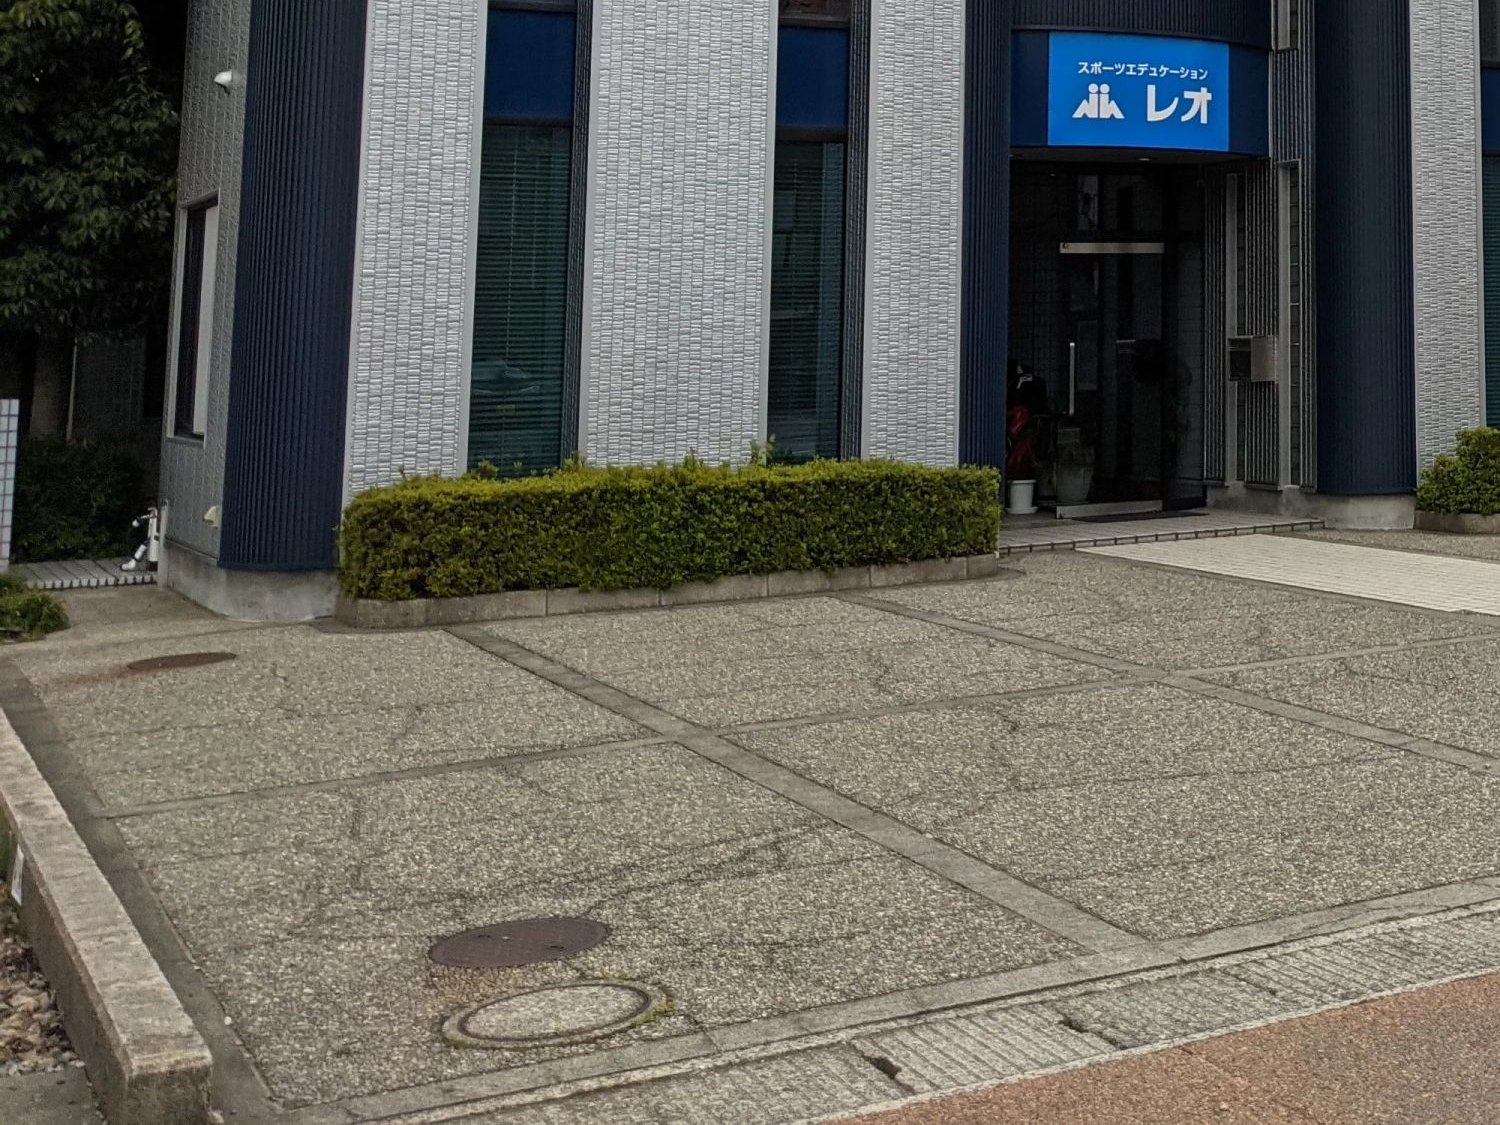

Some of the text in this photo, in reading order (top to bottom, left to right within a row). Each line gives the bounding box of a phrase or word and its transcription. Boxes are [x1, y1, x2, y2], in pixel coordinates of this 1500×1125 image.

[1077, 61, 1209, 81] スポーツエデュケーション
[1146, 83, 1213, 125] レオ
